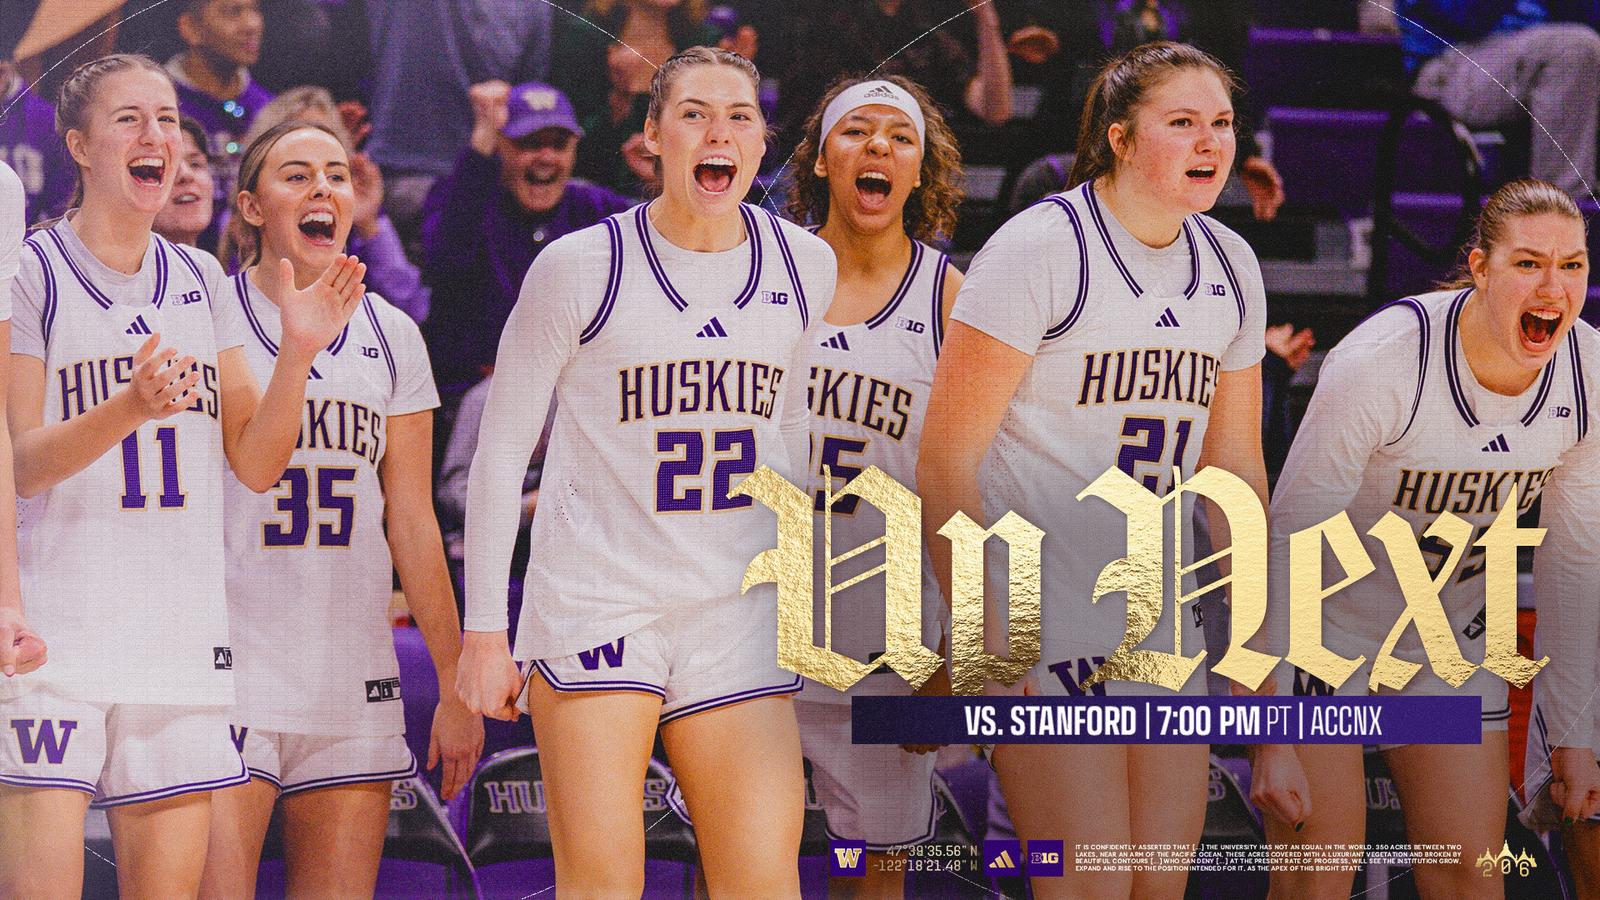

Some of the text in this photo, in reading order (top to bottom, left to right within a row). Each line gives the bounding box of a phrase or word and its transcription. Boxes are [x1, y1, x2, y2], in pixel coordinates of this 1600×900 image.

[618, 358, 785, 424] HUSKIES
[119, 424, 188, 512] 11
[654, 427, 758, 515] 22
[807, 431, 871, 517] 5
[1114, 414, 1194, 496] 21
[260, 464, 359, 550] 35
[10, 718, 78, 764] W
